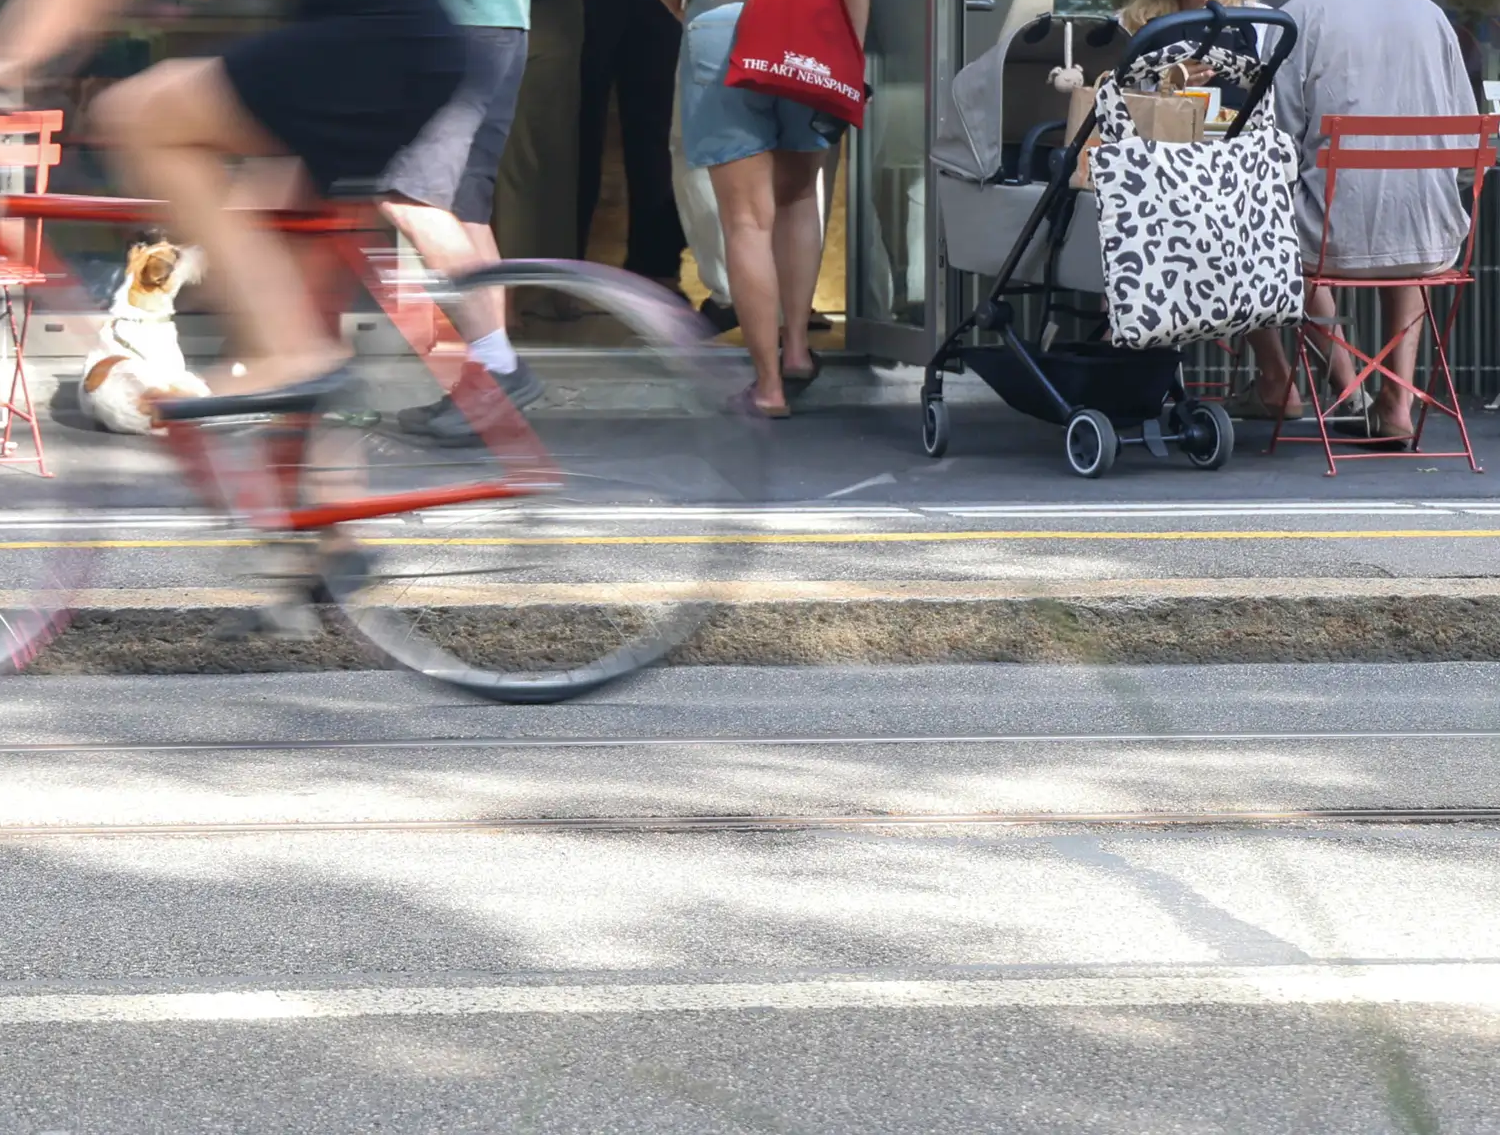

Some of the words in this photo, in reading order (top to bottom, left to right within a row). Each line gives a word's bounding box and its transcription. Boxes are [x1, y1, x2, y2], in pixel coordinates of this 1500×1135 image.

[742, 58, 769, 72] THE
[769, 64, 796, 78] ART
[796, 69, 861, 103] NEWSPAPER
